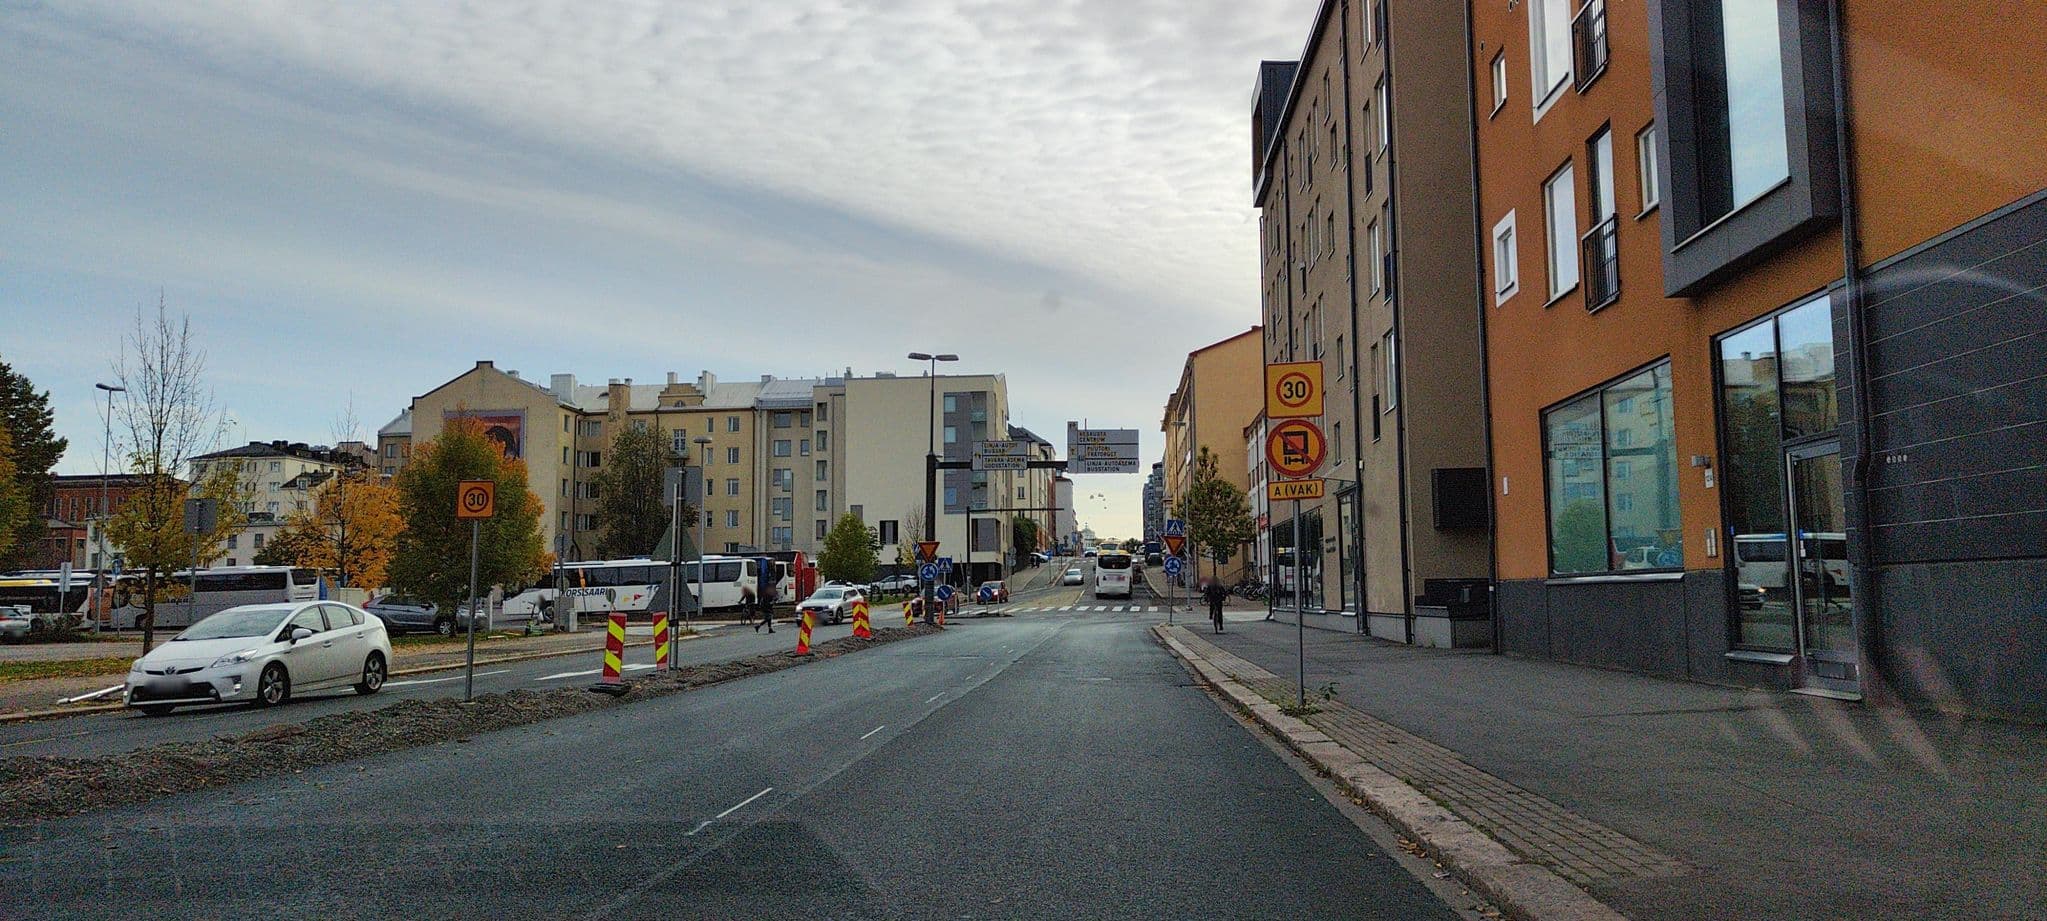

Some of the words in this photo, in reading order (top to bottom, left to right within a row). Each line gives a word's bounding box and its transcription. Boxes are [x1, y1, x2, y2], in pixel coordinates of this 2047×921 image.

[1283, 380, 1306, 399] 30
[1274, 486, 1281, 497] A
[1285, 484, 1319, 498] (VAK)
[468, 492, 485, 507] 30
